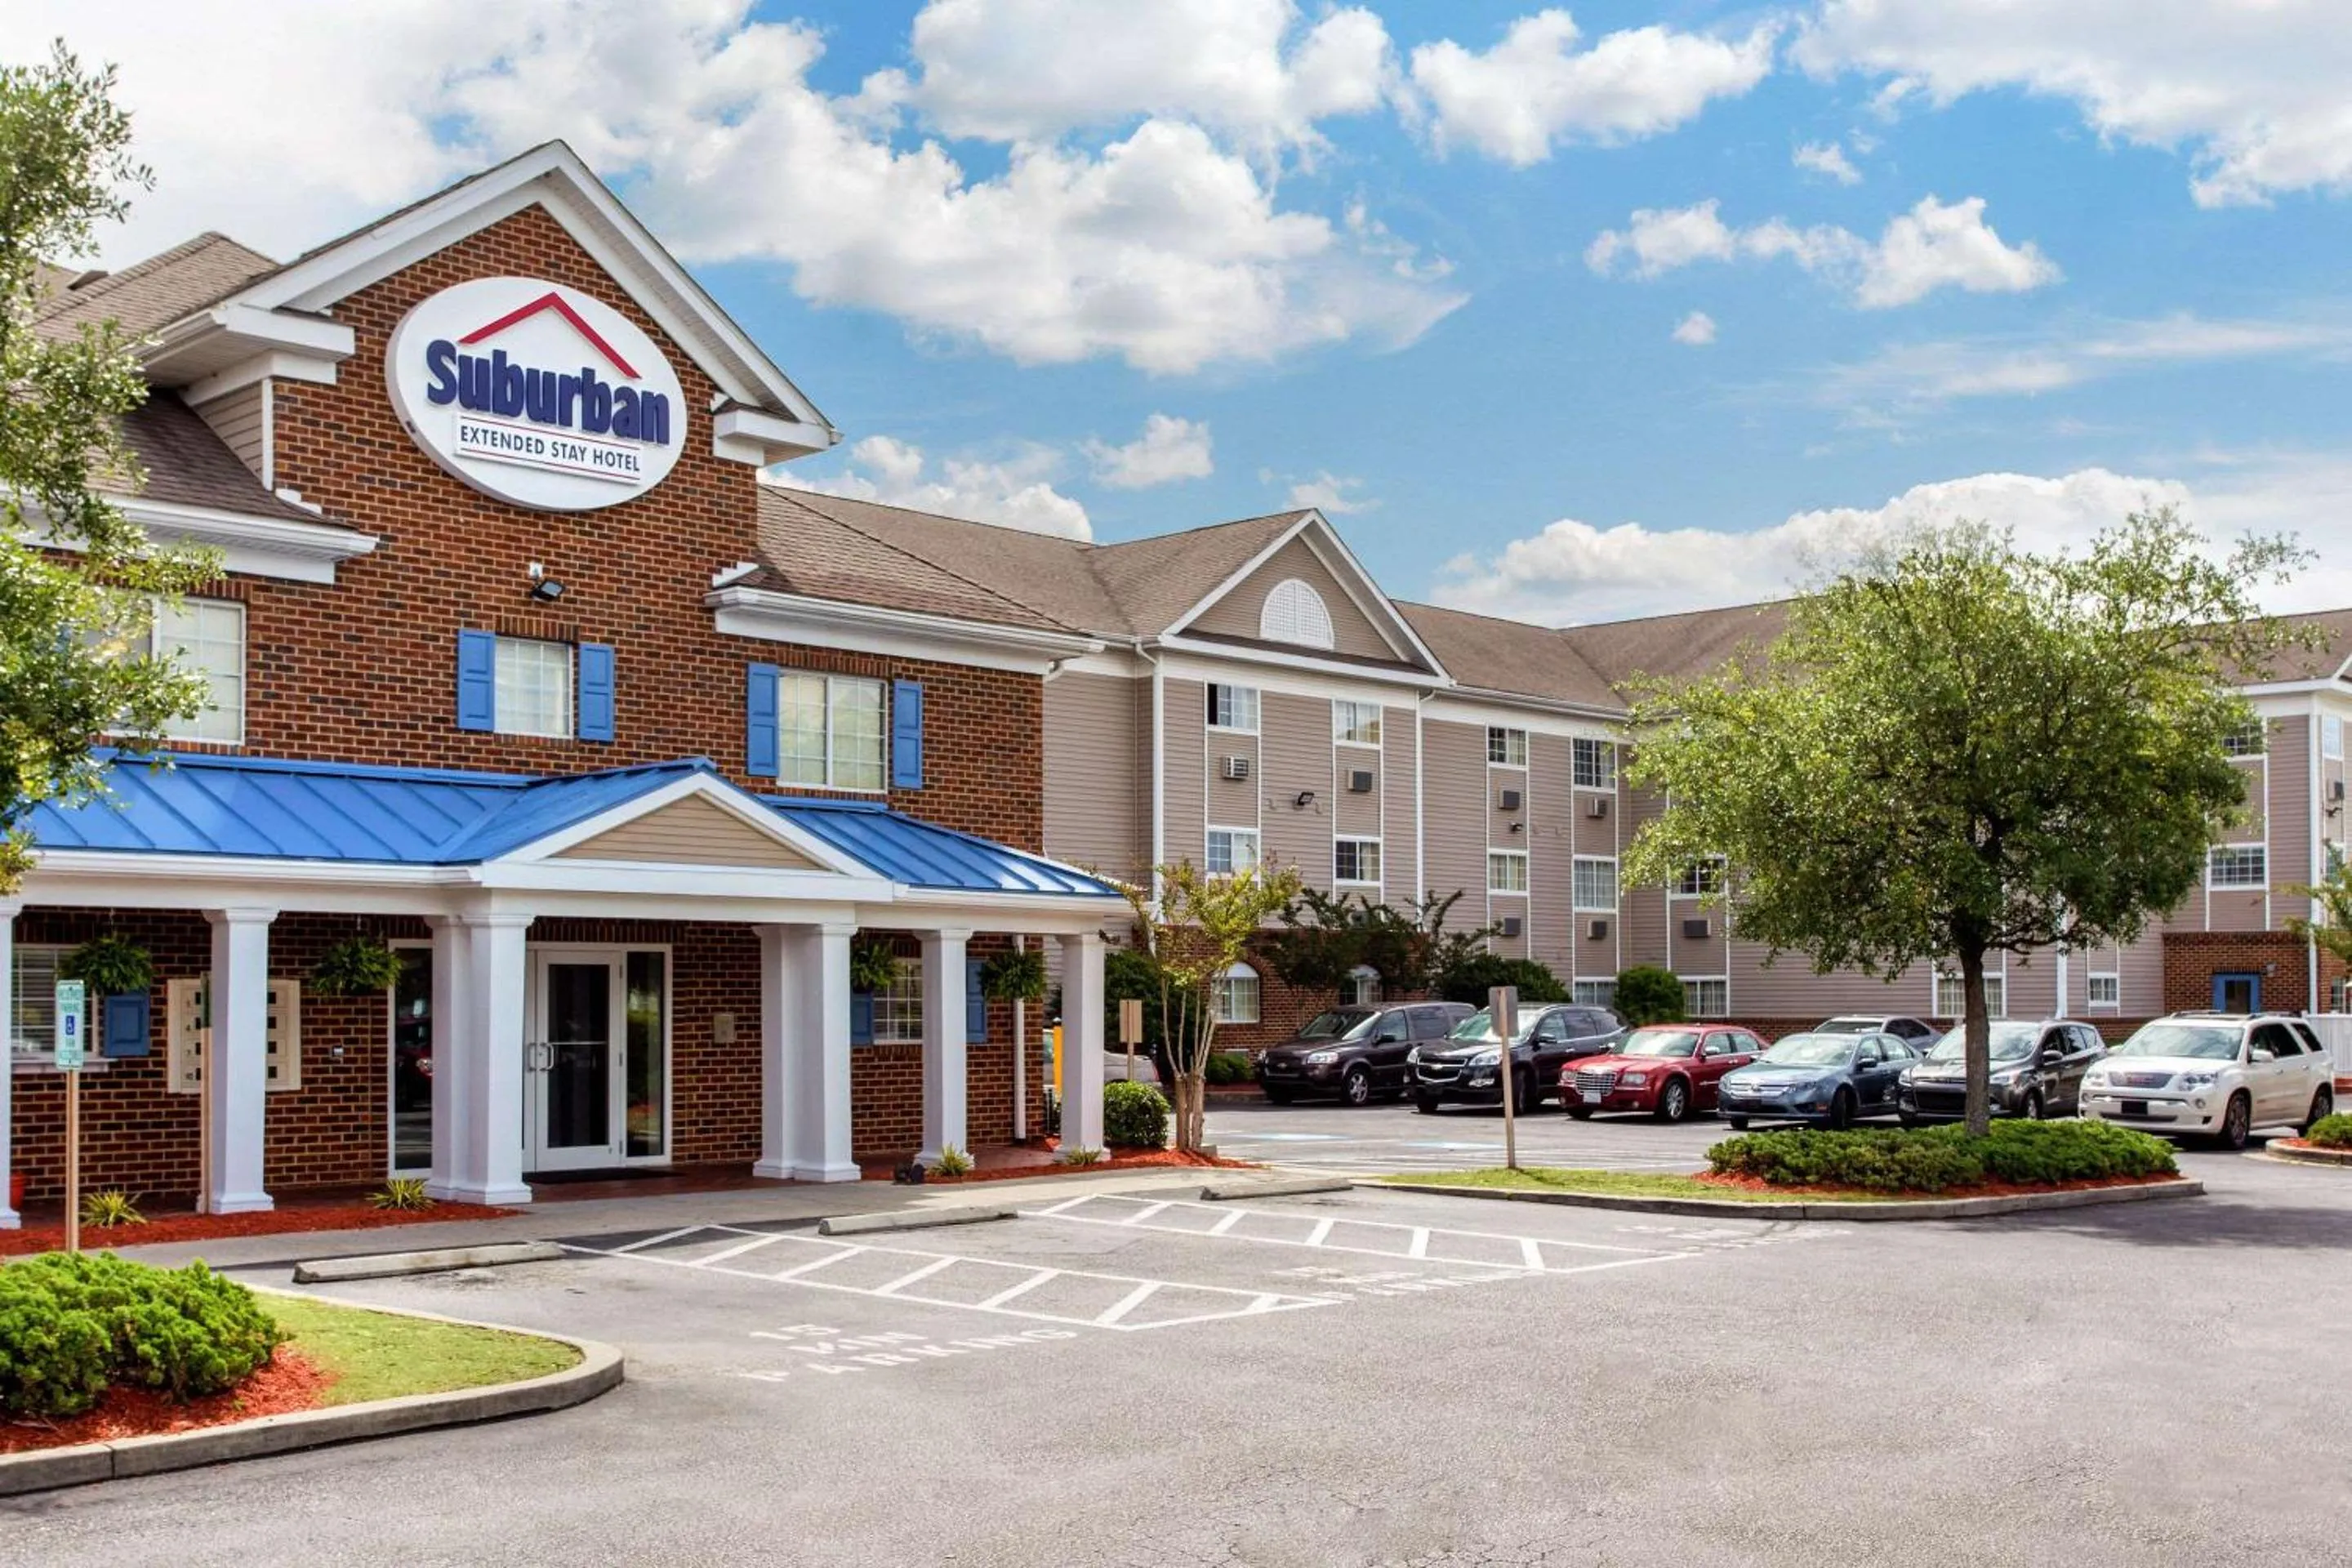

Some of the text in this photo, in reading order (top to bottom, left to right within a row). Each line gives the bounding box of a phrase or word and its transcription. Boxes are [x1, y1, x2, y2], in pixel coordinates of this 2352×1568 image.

[425, 338, 670, 446] Suburban
[460, 425, 640, 472] EXTENDED STAY HOTEL
